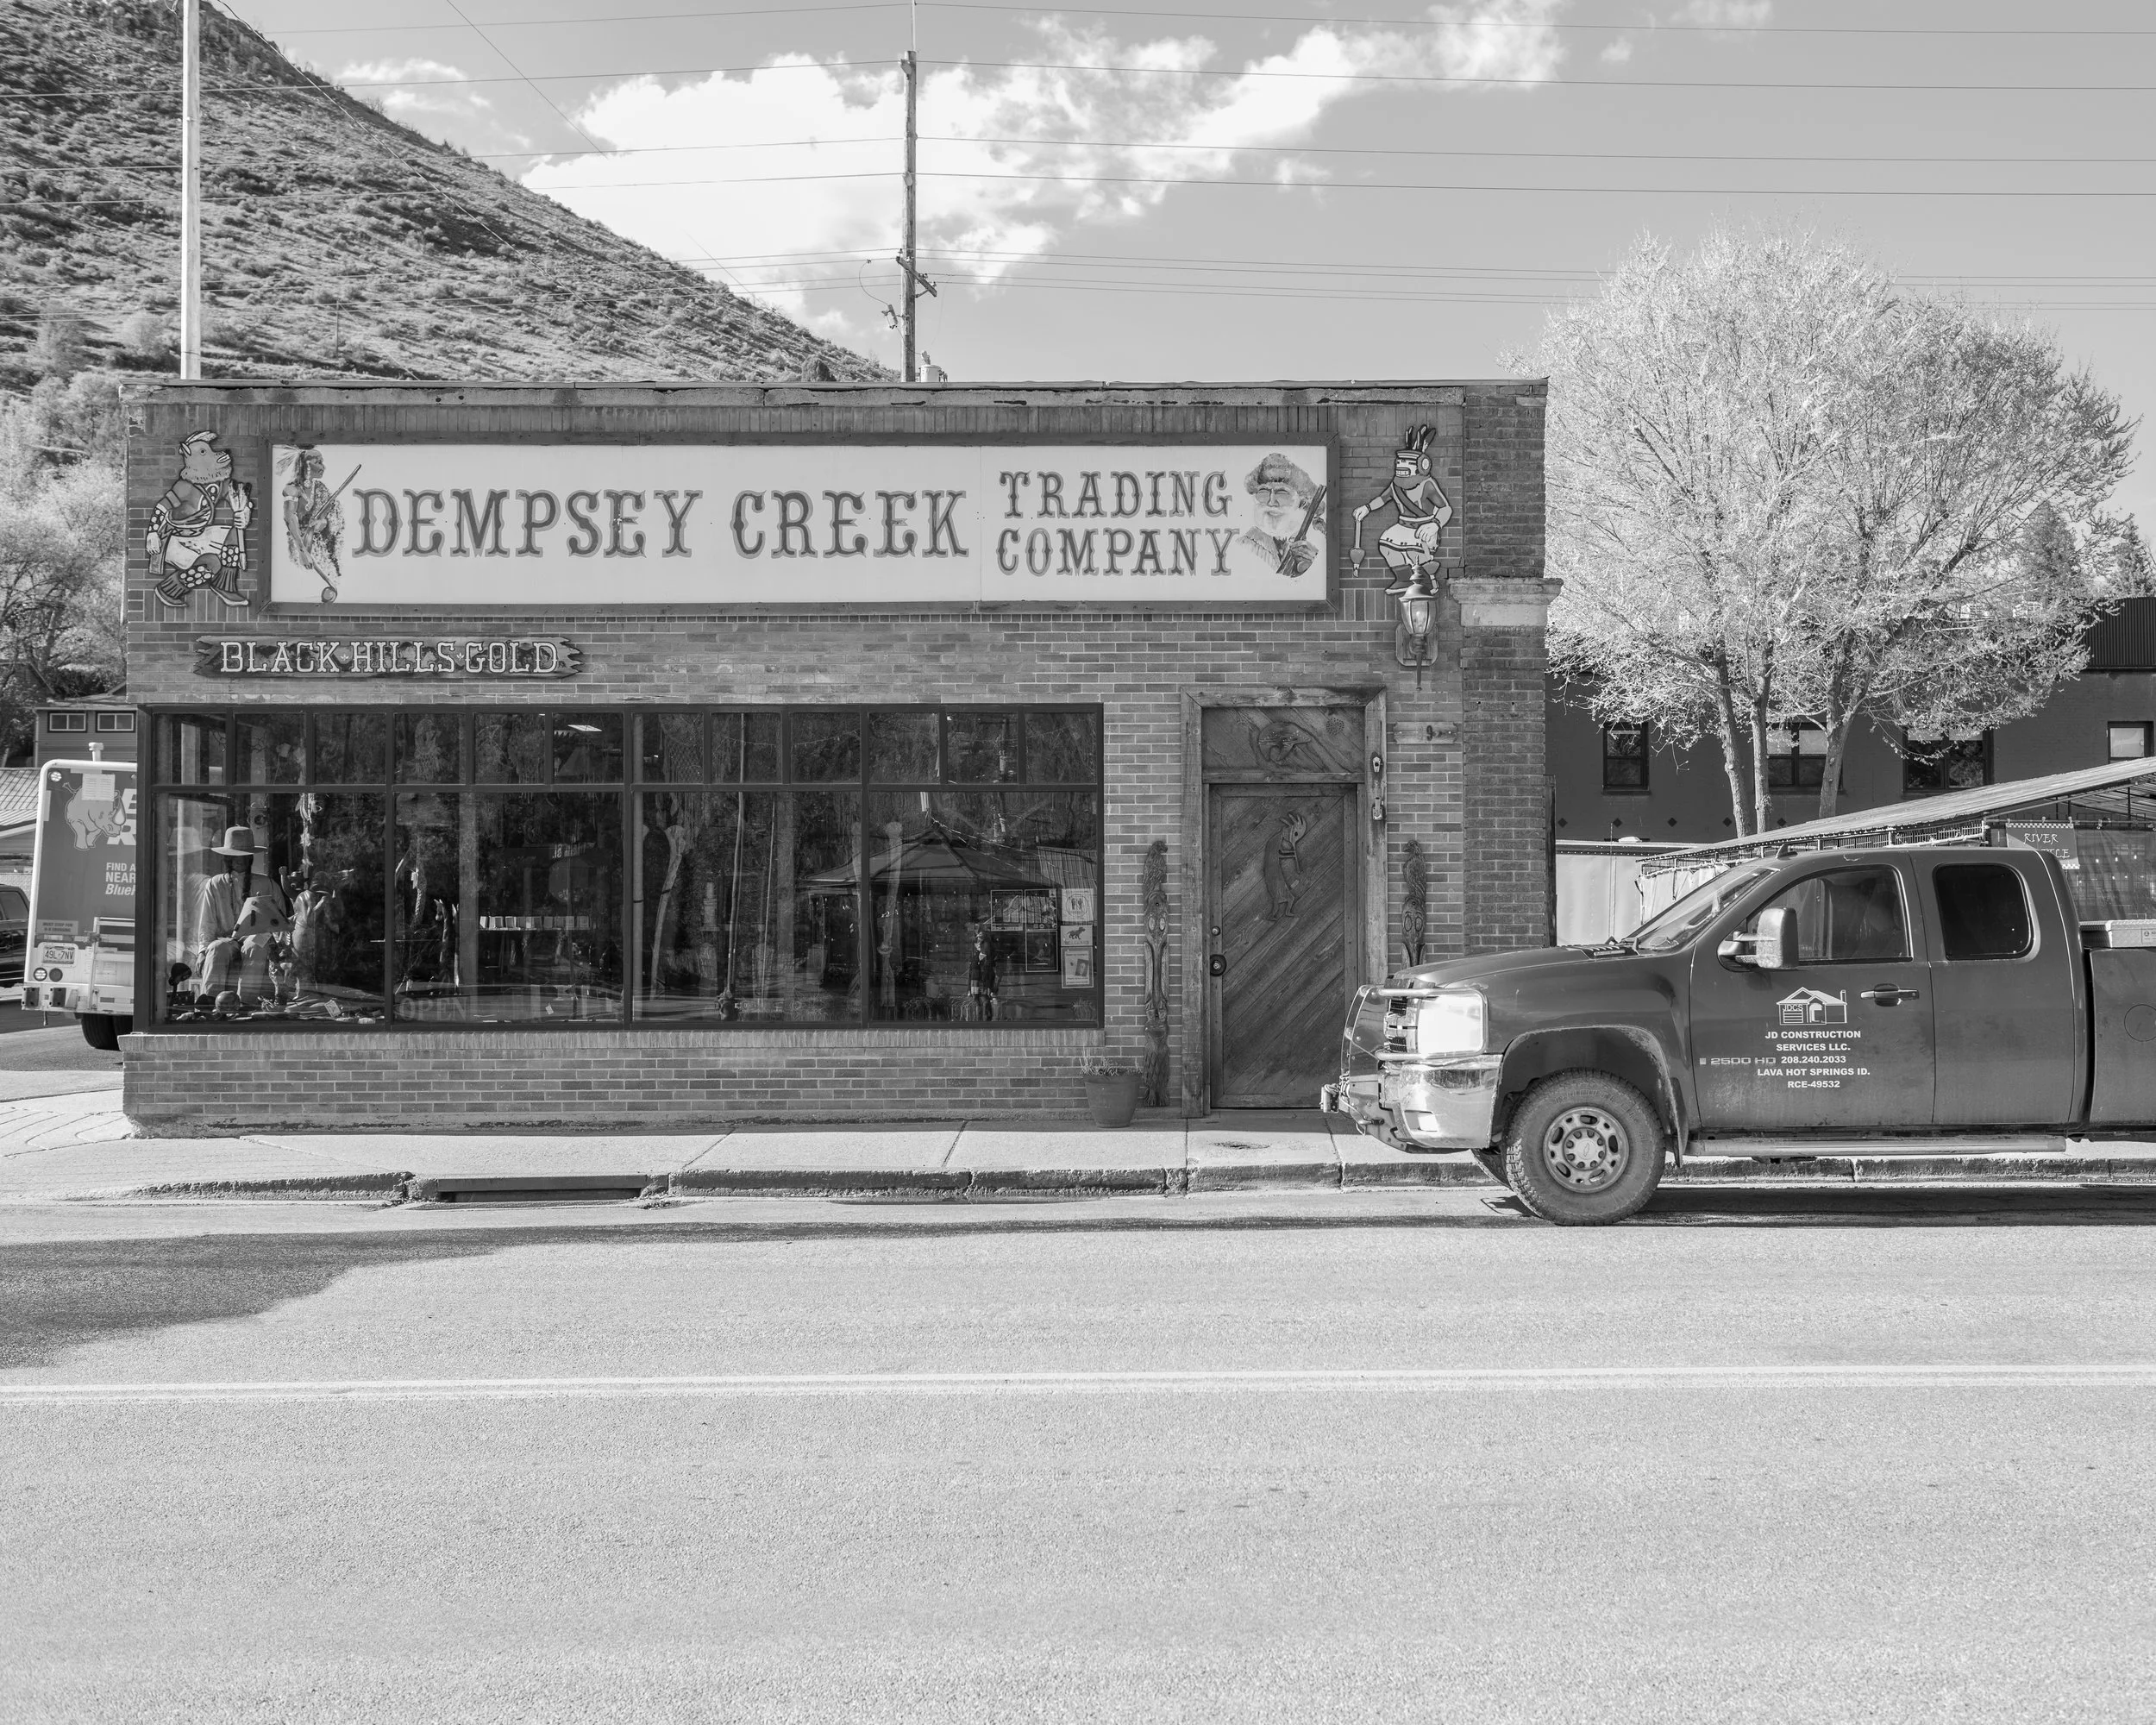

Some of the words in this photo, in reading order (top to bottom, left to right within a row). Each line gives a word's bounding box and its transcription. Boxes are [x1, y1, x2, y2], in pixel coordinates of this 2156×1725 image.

[999, 470, 1232, 518] TRADING
[352, 488, 703, 558] DEMPSEY
[730, 489, 969, 559] CREEK
[996, 527, 1239, 576] COMPANY
[219, 641, 341, 673] BLACK
[350, 640, 455, 674] HILLS
[463, 640, 559, 673] GOLD
[2023, 832, 2059, 845] RIVER
[106, 862, 128, 872] FIND
[399, 996, 467, 1021] OPEN
[1764, 1031, 1778, 1039] JD
[1781, 1030, 1862, 1039] CONSTRUCTION
[1776, 1043, 1827, 1051] SERVICES
[1828, 1043, 1851, 1051] LLC.
[1781, 1055, 1847, 1064] 208.240.2033
[1757, 1068, 1783, 1076] LAVA
[1786, 1068, 1808, 1076] HOT
[1809, 1068, 1854, 1076] SPRINGS
[1857, 1067, 1871, 1076] ID.
[1787, 1080, 1840, 1089] RCE-49532
